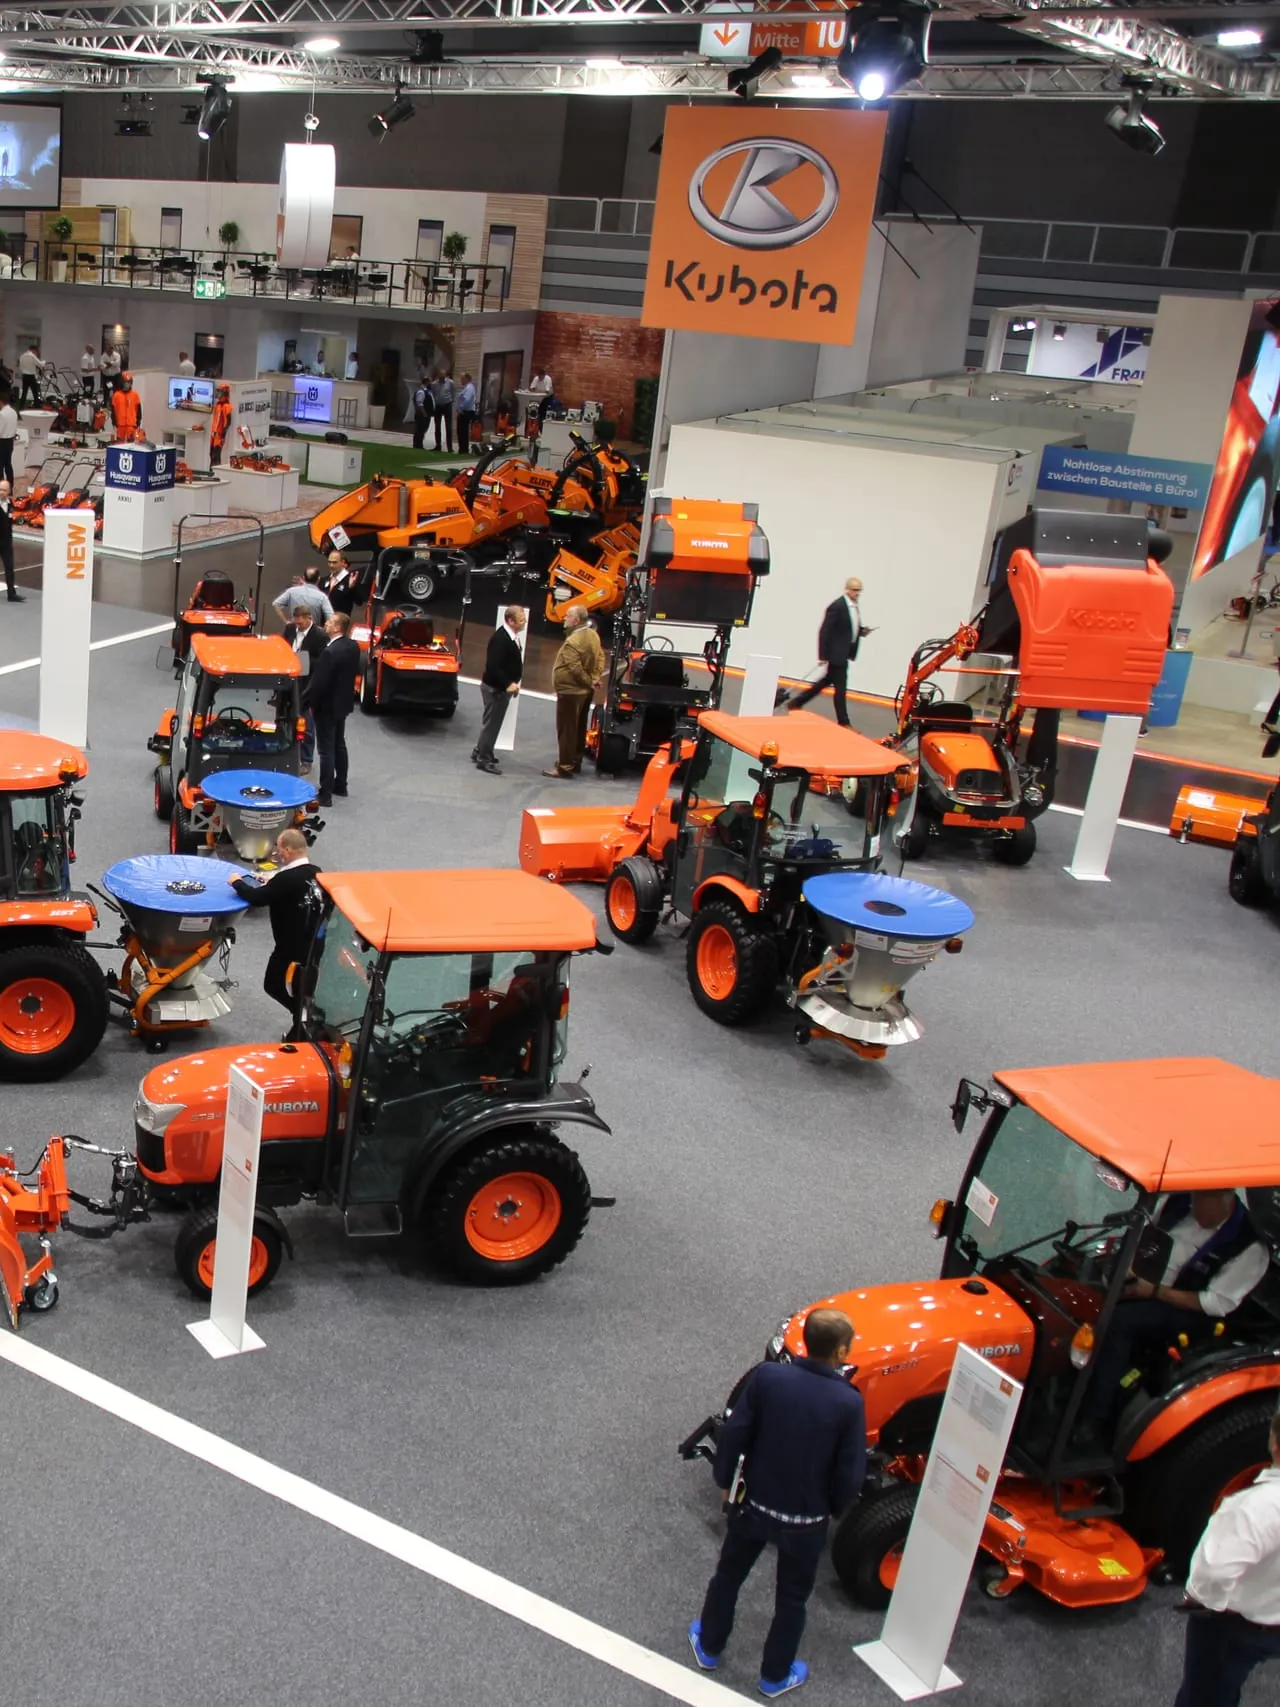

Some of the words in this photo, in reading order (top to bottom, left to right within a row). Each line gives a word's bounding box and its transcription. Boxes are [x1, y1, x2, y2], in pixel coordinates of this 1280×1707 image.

[753, 33, 800, 48] Mitte
[664, 259, 838, 314] Kubota
[109, 471, 141, 483] Husqvarna
[1047, 471, 1098, 485] zwischen
[1063, 458, 1112, 474] Nahtlose
[1114, 465, 1187, 485] Abstimmung
[66, 522, 87, 580] NEW
[263, 1101, 320, 1114] KUBOTA
[976, 1343, 1022, 1359] UBOTA
